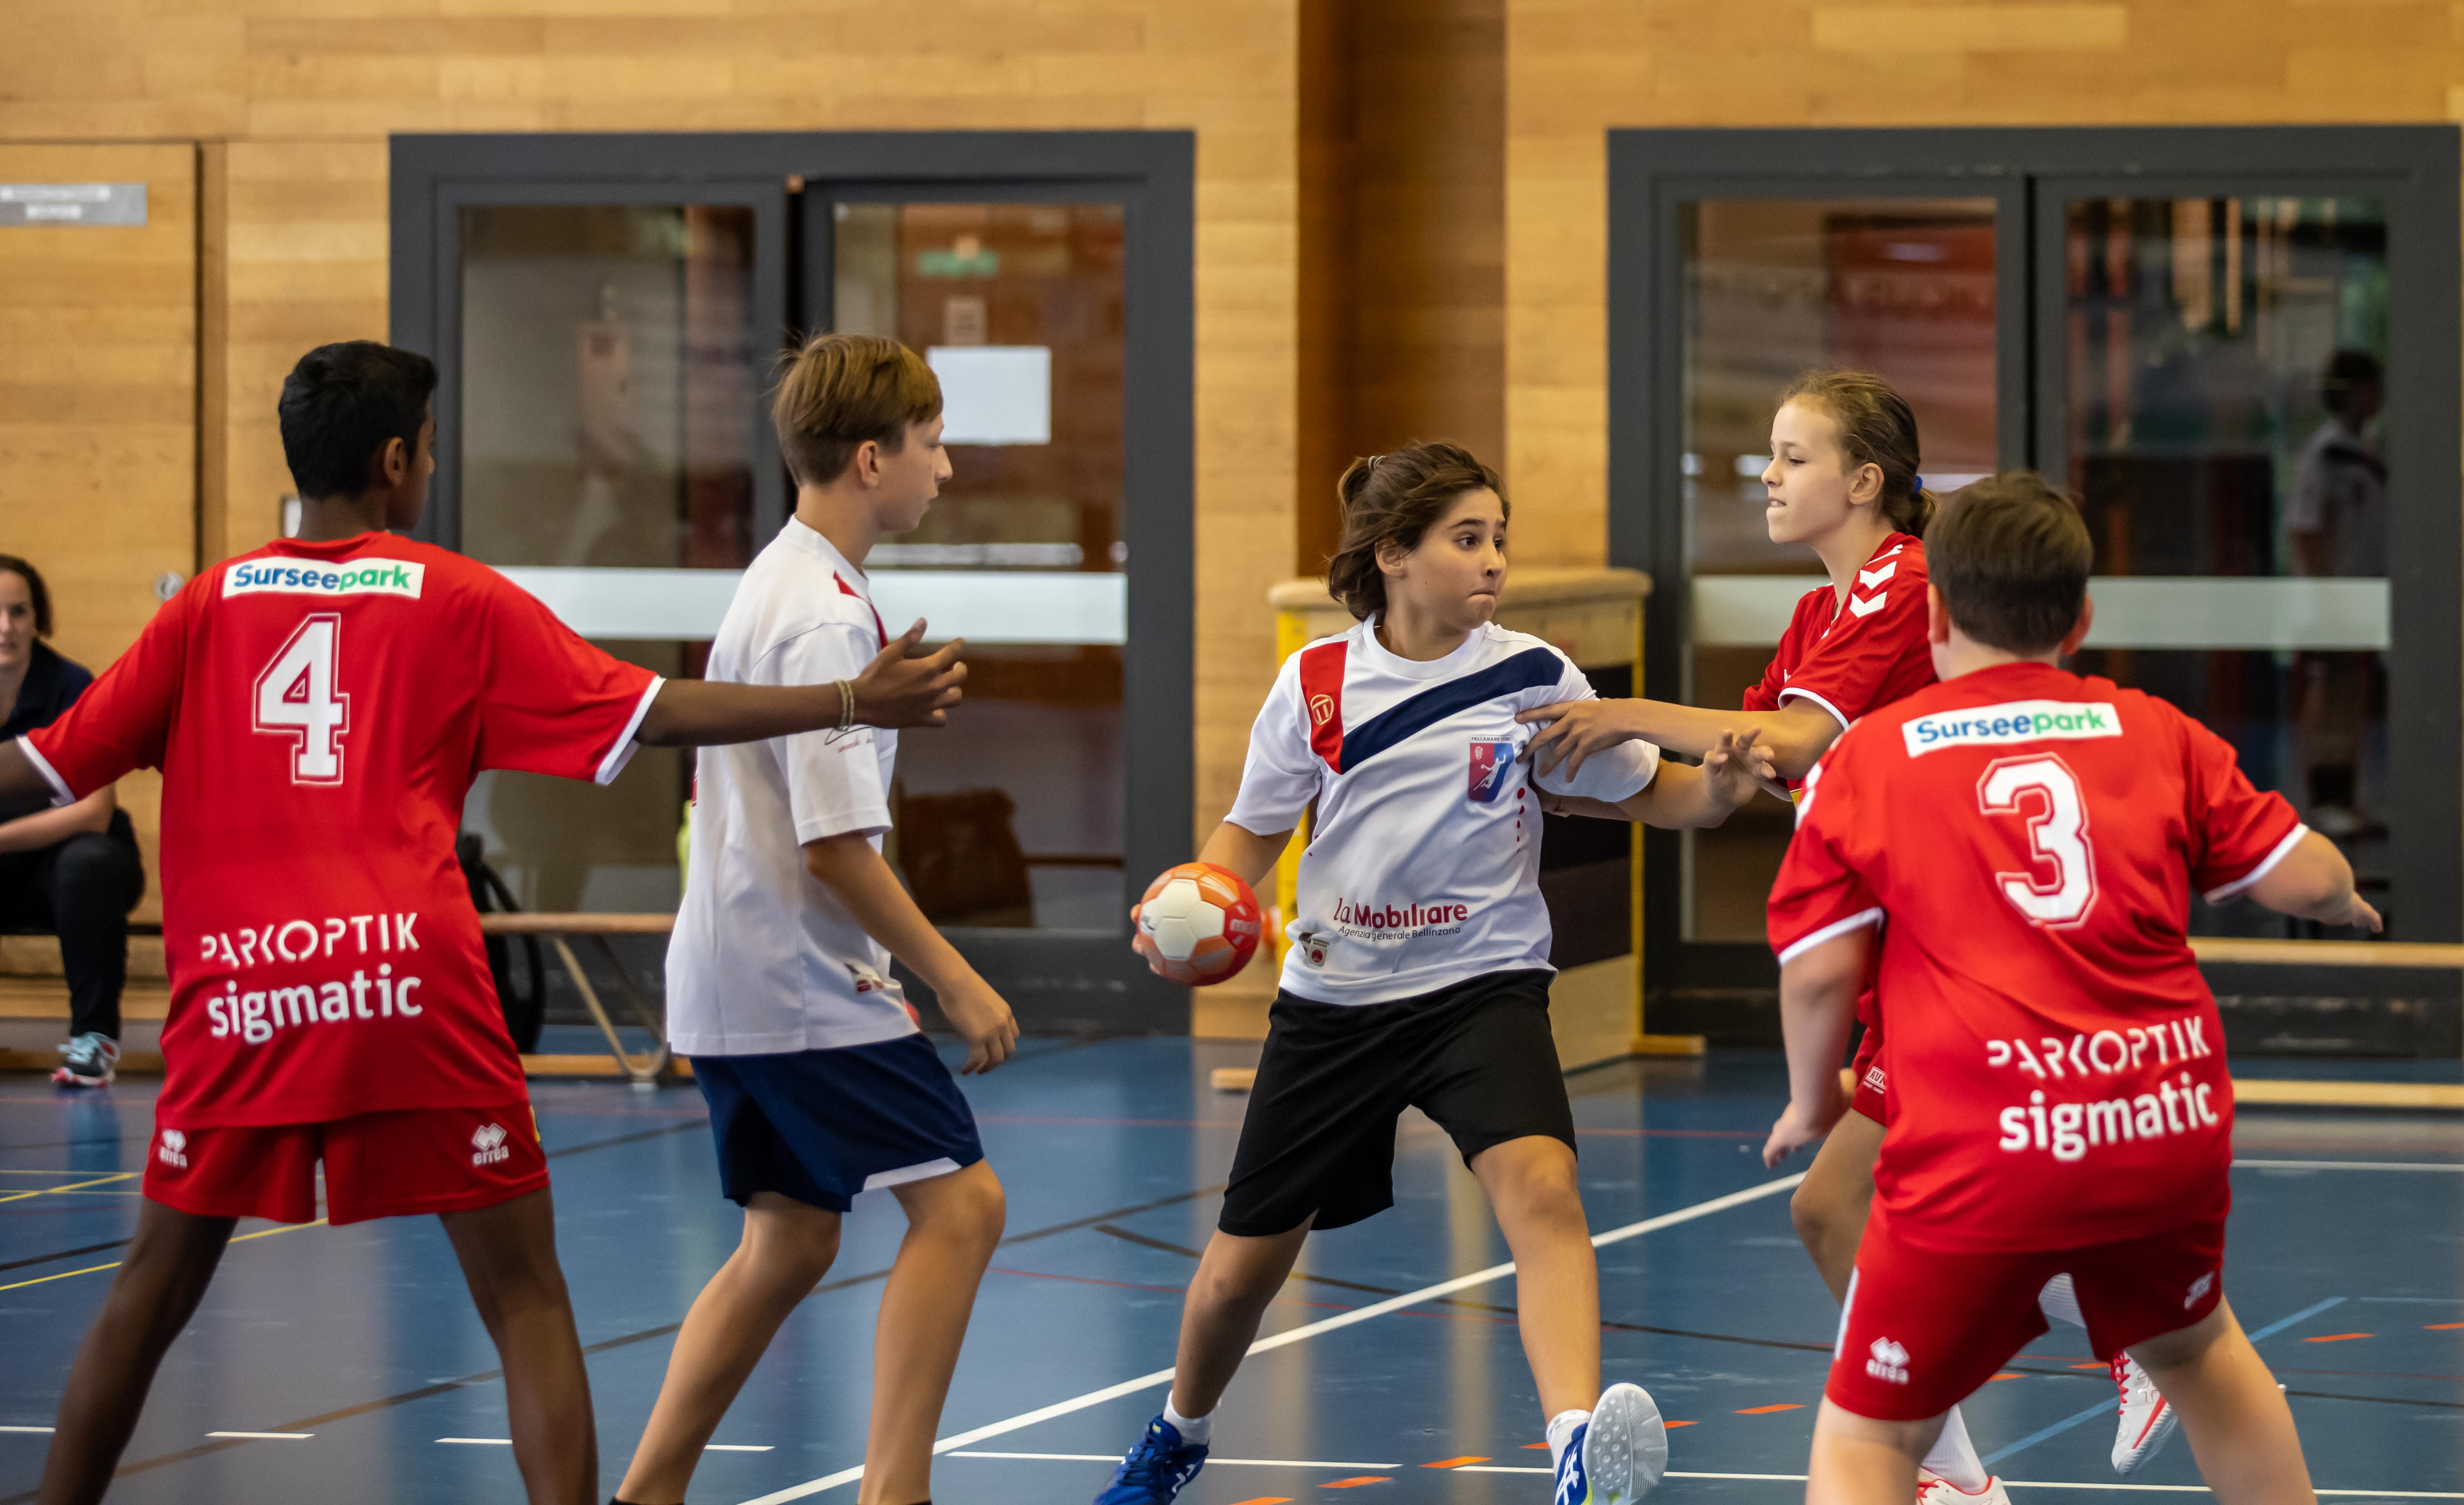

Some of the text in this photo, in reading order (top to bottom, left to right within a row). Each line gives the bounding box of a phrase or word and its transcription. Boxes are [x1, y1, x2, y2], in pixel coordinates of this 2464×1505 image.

[234, 564, 411, 592] Surseepark
[252, 613, 350, 786] 4
[1917, 708, 2106, 743] Surseepark
[1976, 752, 2099, 929] 3
[202, 912, 420, 968] PARKOPTIK
[1334, 898, 1468, 929] la Mobiliare
[1338, 926, 1461, 941] Agenzia generale Bellinzona
[208, 963, 423, 1043] sigmatic
[1987, 1015, 2212, 1079] PARKOPTIK
[1999, 1071, 2218, 1162] sigmatic
